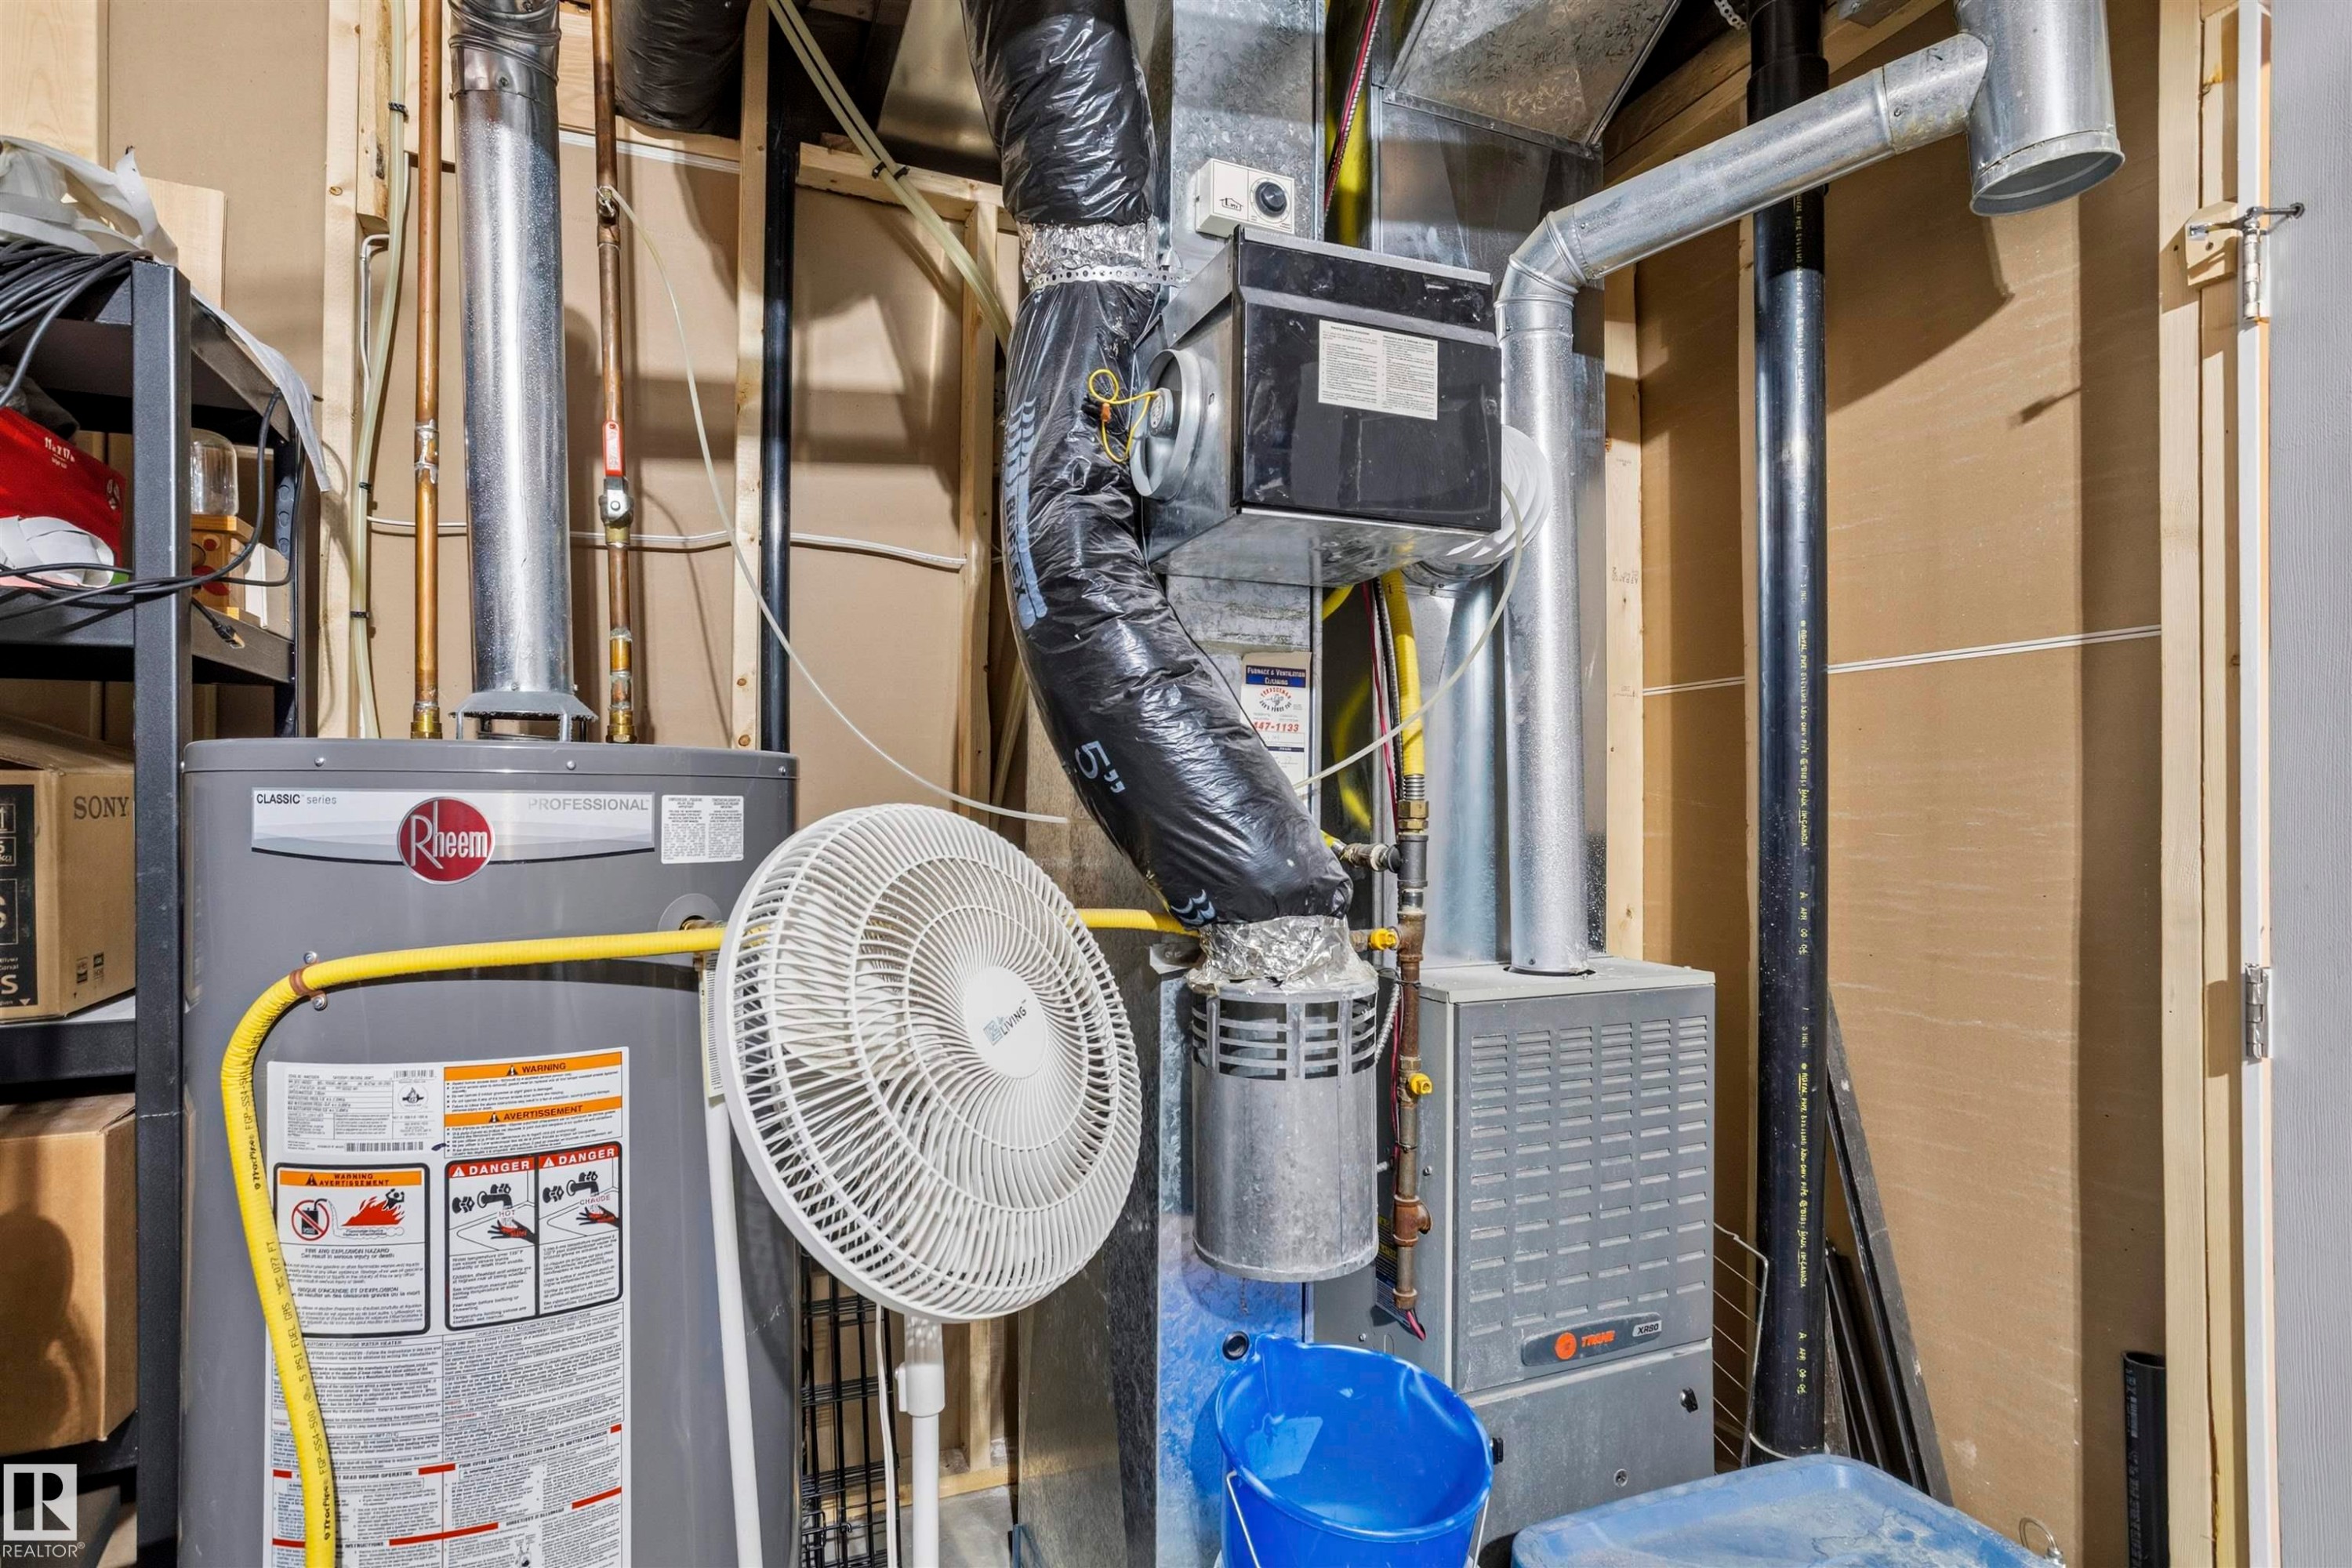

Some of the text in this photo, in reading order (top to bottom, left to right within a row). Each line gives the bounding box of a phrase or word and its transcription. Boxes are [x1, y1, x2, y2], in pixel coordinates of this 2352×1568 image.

[256, 793, 337, 804] CLASSIC series
[528, 798, 648, 811] PROFESSIONAL
[73, 795, 129, 820] SONY
[410, 800, 488, 869] Rheem
[1000, 1006, 1027, 1036] LIVING
[522, 1062, 566, 1073] WARNING
[503, 1105, 583, 1120] AVERTISSEMENT
[558, 1149, 615, 1165] DANGER
[469, 1160, 530, 1175] DANGER
[579, 1194, 611, 1205] CHAUDE
[266, 1240, 277, 1252] FT
[281, 1301, 292, 1320] GAS
[288, 1325, 299, 1348] FUEL
[294, 1352, 304, 1371] PSI
[307, 1410, 328, 1475] FGP-SS4-500
